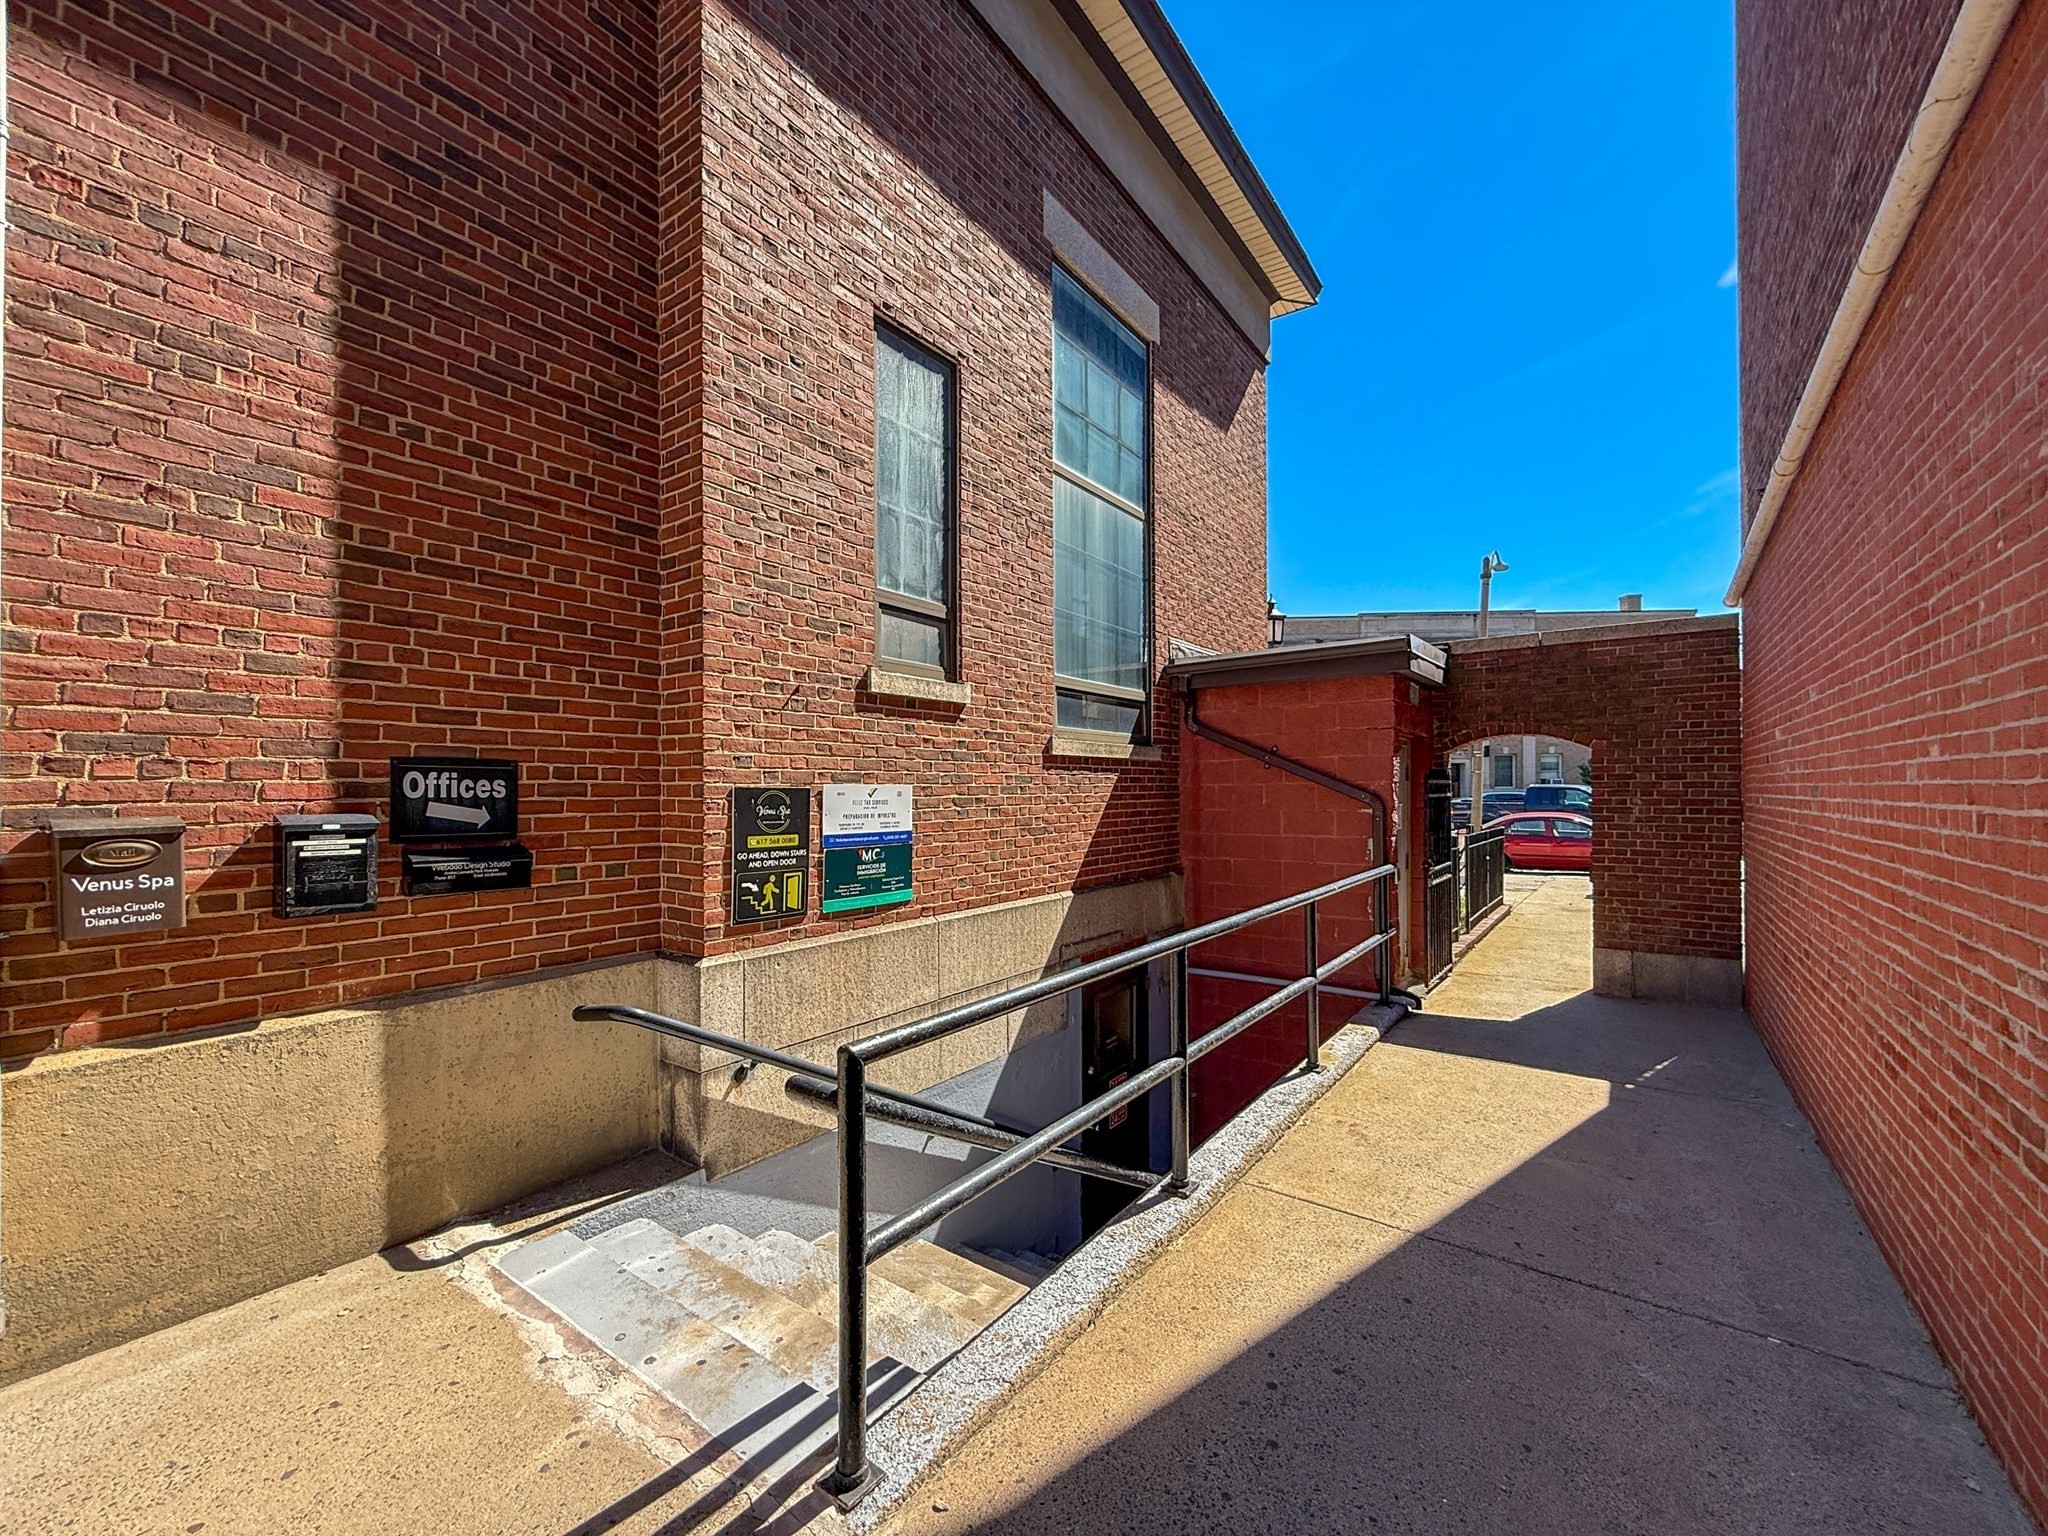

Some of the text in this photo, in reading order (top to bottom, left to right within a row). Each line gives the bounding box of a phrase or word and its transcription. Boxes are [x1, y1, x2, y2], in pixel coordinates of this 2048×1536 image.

[402, 771, 507, 799] Offices
[756, 805, 791, 820] Venus Spa
[768, 838, 780, 846] 568
[770, 850, 790, 858] DOWN
[862, 848, 881, 861] MC
[464, 862, 488, 870] Design
[748, 860, 762, 868] AND
[780, 858, 797, 866] DOOR
[856, 863, 880, 871] SERVICIOS
[71, 874, 175, 893] Venus Spa
[81, 901, 165, 917] Letizia Ciruolo
[85, 912, 162, 928] Diana Ciruolo
